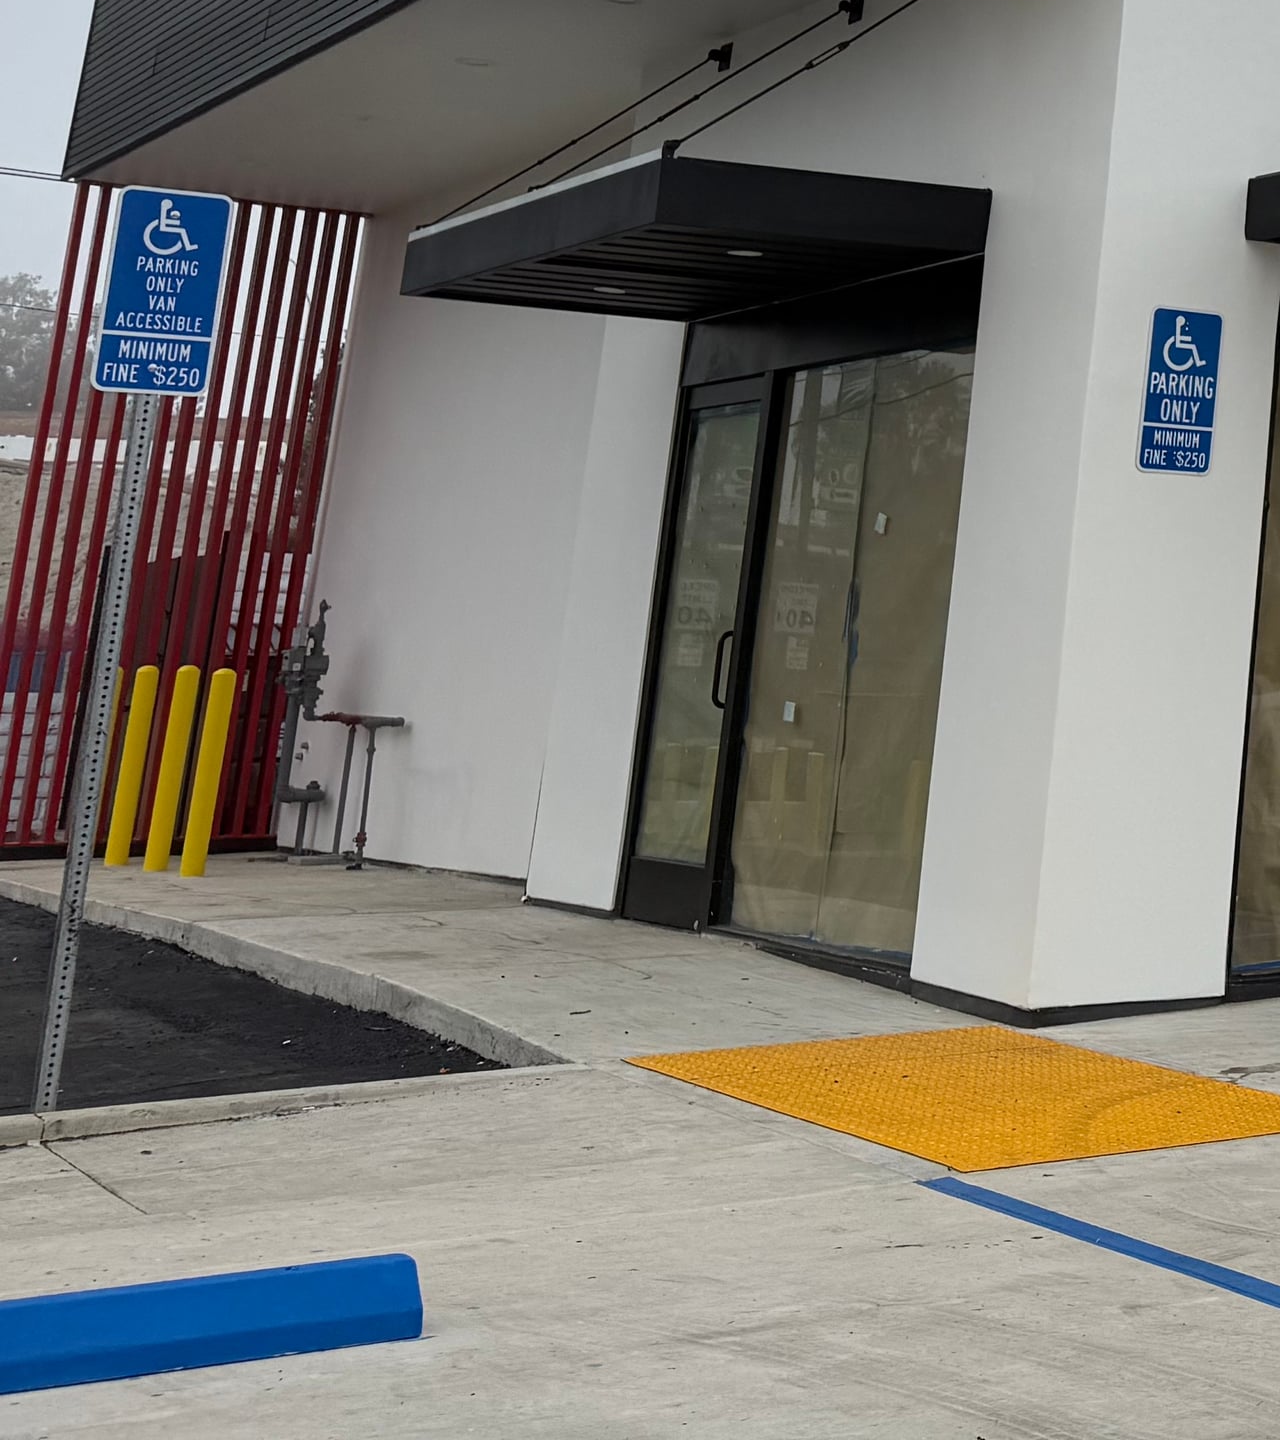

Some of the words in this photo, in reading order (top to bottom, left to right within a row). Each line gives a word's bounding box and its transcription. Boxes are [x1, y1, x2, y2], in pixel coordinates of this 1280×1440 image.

[136, 256, 199, 277] PARKING
[146, 276, 185, 294] ONLY
[149, 295, 176, 312] VAN
[115, 312, 203, 333] ACCESSIBLE
[118, 339, 192, 363] MINIMUM
[102, 363, 140, 384] FINE
[153, 365, 200, 388] $250
[1150, 371, 1215, 400] PARKING
[1160, 398, 1201, 424] ONLY
[1153, 429, 1200, 449] MINIMUM
[1143, 448, 1168, 466] FINE
[1175, 450, 1206, 469] $250
